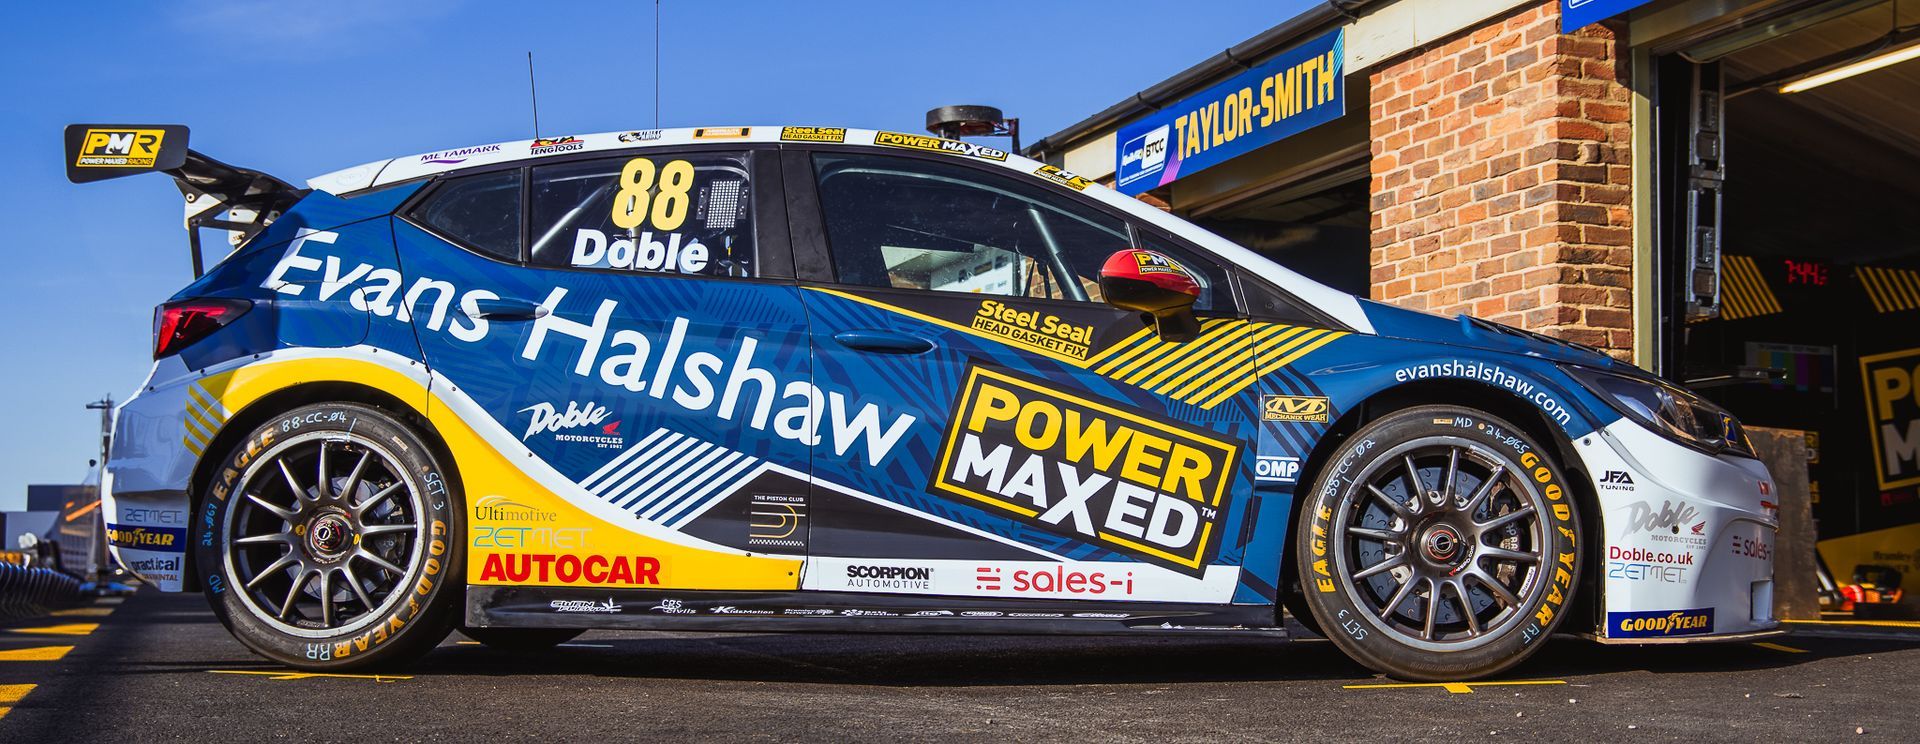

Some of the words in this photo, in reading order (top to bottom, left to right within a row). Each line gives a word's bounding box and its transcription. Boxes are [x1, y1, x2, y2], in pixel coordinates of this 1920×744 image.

[1175, 50, 1334, 161] TAYLOR-SMITH
[783, 126, 815, 134] Steel
[818, 127, 844, 135] Seal
[85, 133, 158, 154] PMR
[420, 144, 501, 161] METAMARK
[879, 133, 939, 149] POWER
[942, 140, 1004, 158] MAXED
[1146, 138, 1164, 157] BTCC
[612, 158, 695, 231] 88
[571, 228, 709, 273] Doble
[977, 300, 1040, 331] Steel
[1040, 315, 1094, 345] Seal
[259, 227, 500, 342] Evans
[521, 286, 917, 467] Halshaw
[974, 318, 1010, 336] HEAD
[1011, 329, 1063, 350] GASKET
[1065, 344, 1086, 357] FIX
[1395, 360, 1571, 426] evanshalshaw.com
[516, 400, 613, 442] Doble
[1265, 412, 1303, 421] MECHANIX
[1304, 413, 1326, 421] WEAR
[1454, 417, 1473, 428] MD
[555, 435, 623, 444] MOTORCYCLES
[968, 382, 1212, 503] POWER
[213, 427, 275, 501] EAGLE
[1255, 460, 1299, 477] OMP
[423, 471, 446, 496] SET
[1600, 470, 1634, 484] JFA
[952, 433, 1199, 549] MAXED
[433, 501, 445, 511] 3
[475, 506, 556, 521] Ultimotive
[1612, 500, 1699, 542] Doble
[1311, 504, 1336, 593] EAGLE
[1651, 534, 1707, 546] MOTORCYCLES
[131, 557, 179, 571] practical
[1609, 546, 1693, 565] Doble.co.uk
[479, 553, 661, 585] AUTOCAR
[1013, 565, 1133, 594] sales-i
[208, 574, 226, 594] MD
[847, 578, 929, 589] AUTOMOTIVE
[1338, 609, 1349, 619] 3
[1620, 612, 1707, 634] GOODYEAR
[1342, 615, 1368, 640] SET
[306, 642, 331, 661] RR
